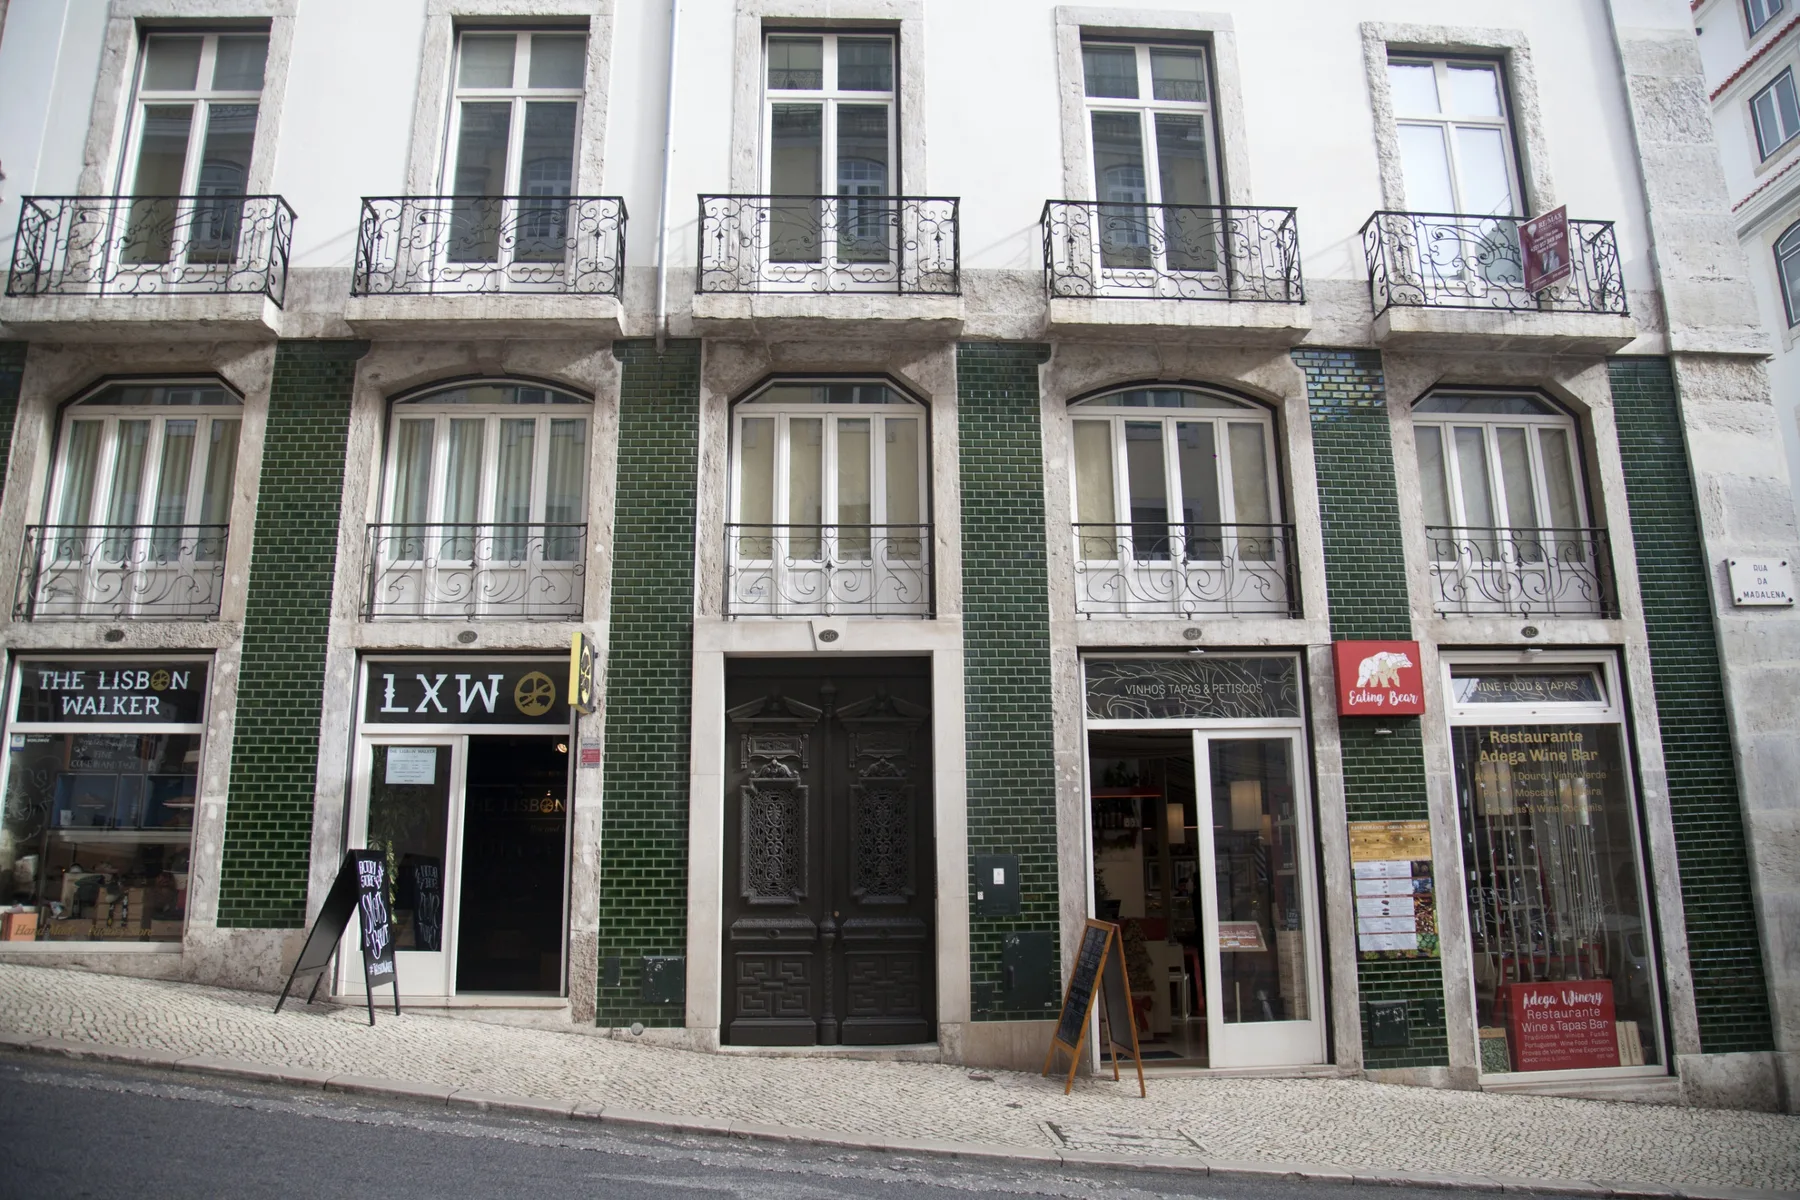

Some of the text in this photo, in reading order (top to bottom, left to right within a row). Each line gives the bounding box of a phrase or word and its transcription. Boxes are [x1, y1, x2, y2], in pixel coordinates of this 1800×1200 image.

[1753, 564, 1768, 572] RUA
[462, 630, 474, 640] 68
[824, 631, 835, 640] 66
[1188, 629, 1199, 638] 64
[1525, 628, 1536, 636] 62
[38, 669, 191, 692] THE LISBON
[1124, 683, 1263, 694] VINHOS TAPAS & PETISCOS
[1504, 682, 1533, 691] FOOD
[1535, 682, 1543, 691] &
[1544, 681, 1579, 691] TAPAS
[380, 673, 504, 714] LXW
[1348, 689, 1418, 706] Eating Bear
[62, 696, 160, 715] WALKER
[1489, 730, 1584, 744] Restaurante
[1480, 748, 1599, 766] Adega Wine Bar
[1518, 772, 1547, 780] Douro
[1553, 771, 1578, 780] Vinho
[1579, 771, 1607, 779] Verde
[1537, 804, 1560, 813] Wine
[1523, 990, 1603, 1010] Adega Winery
[1527, 1008, 1600, 1020] Restaurante
[1522, 1022, 1548, 1032] Wine
[1556, 1021, 1587, 1032] Tapas
[1589, 1019, 1608, 1029] Bar
[1524, 1033, 1560, 1041] Tradicional
[1525, 1041, 1556, 1049] Portuguese
